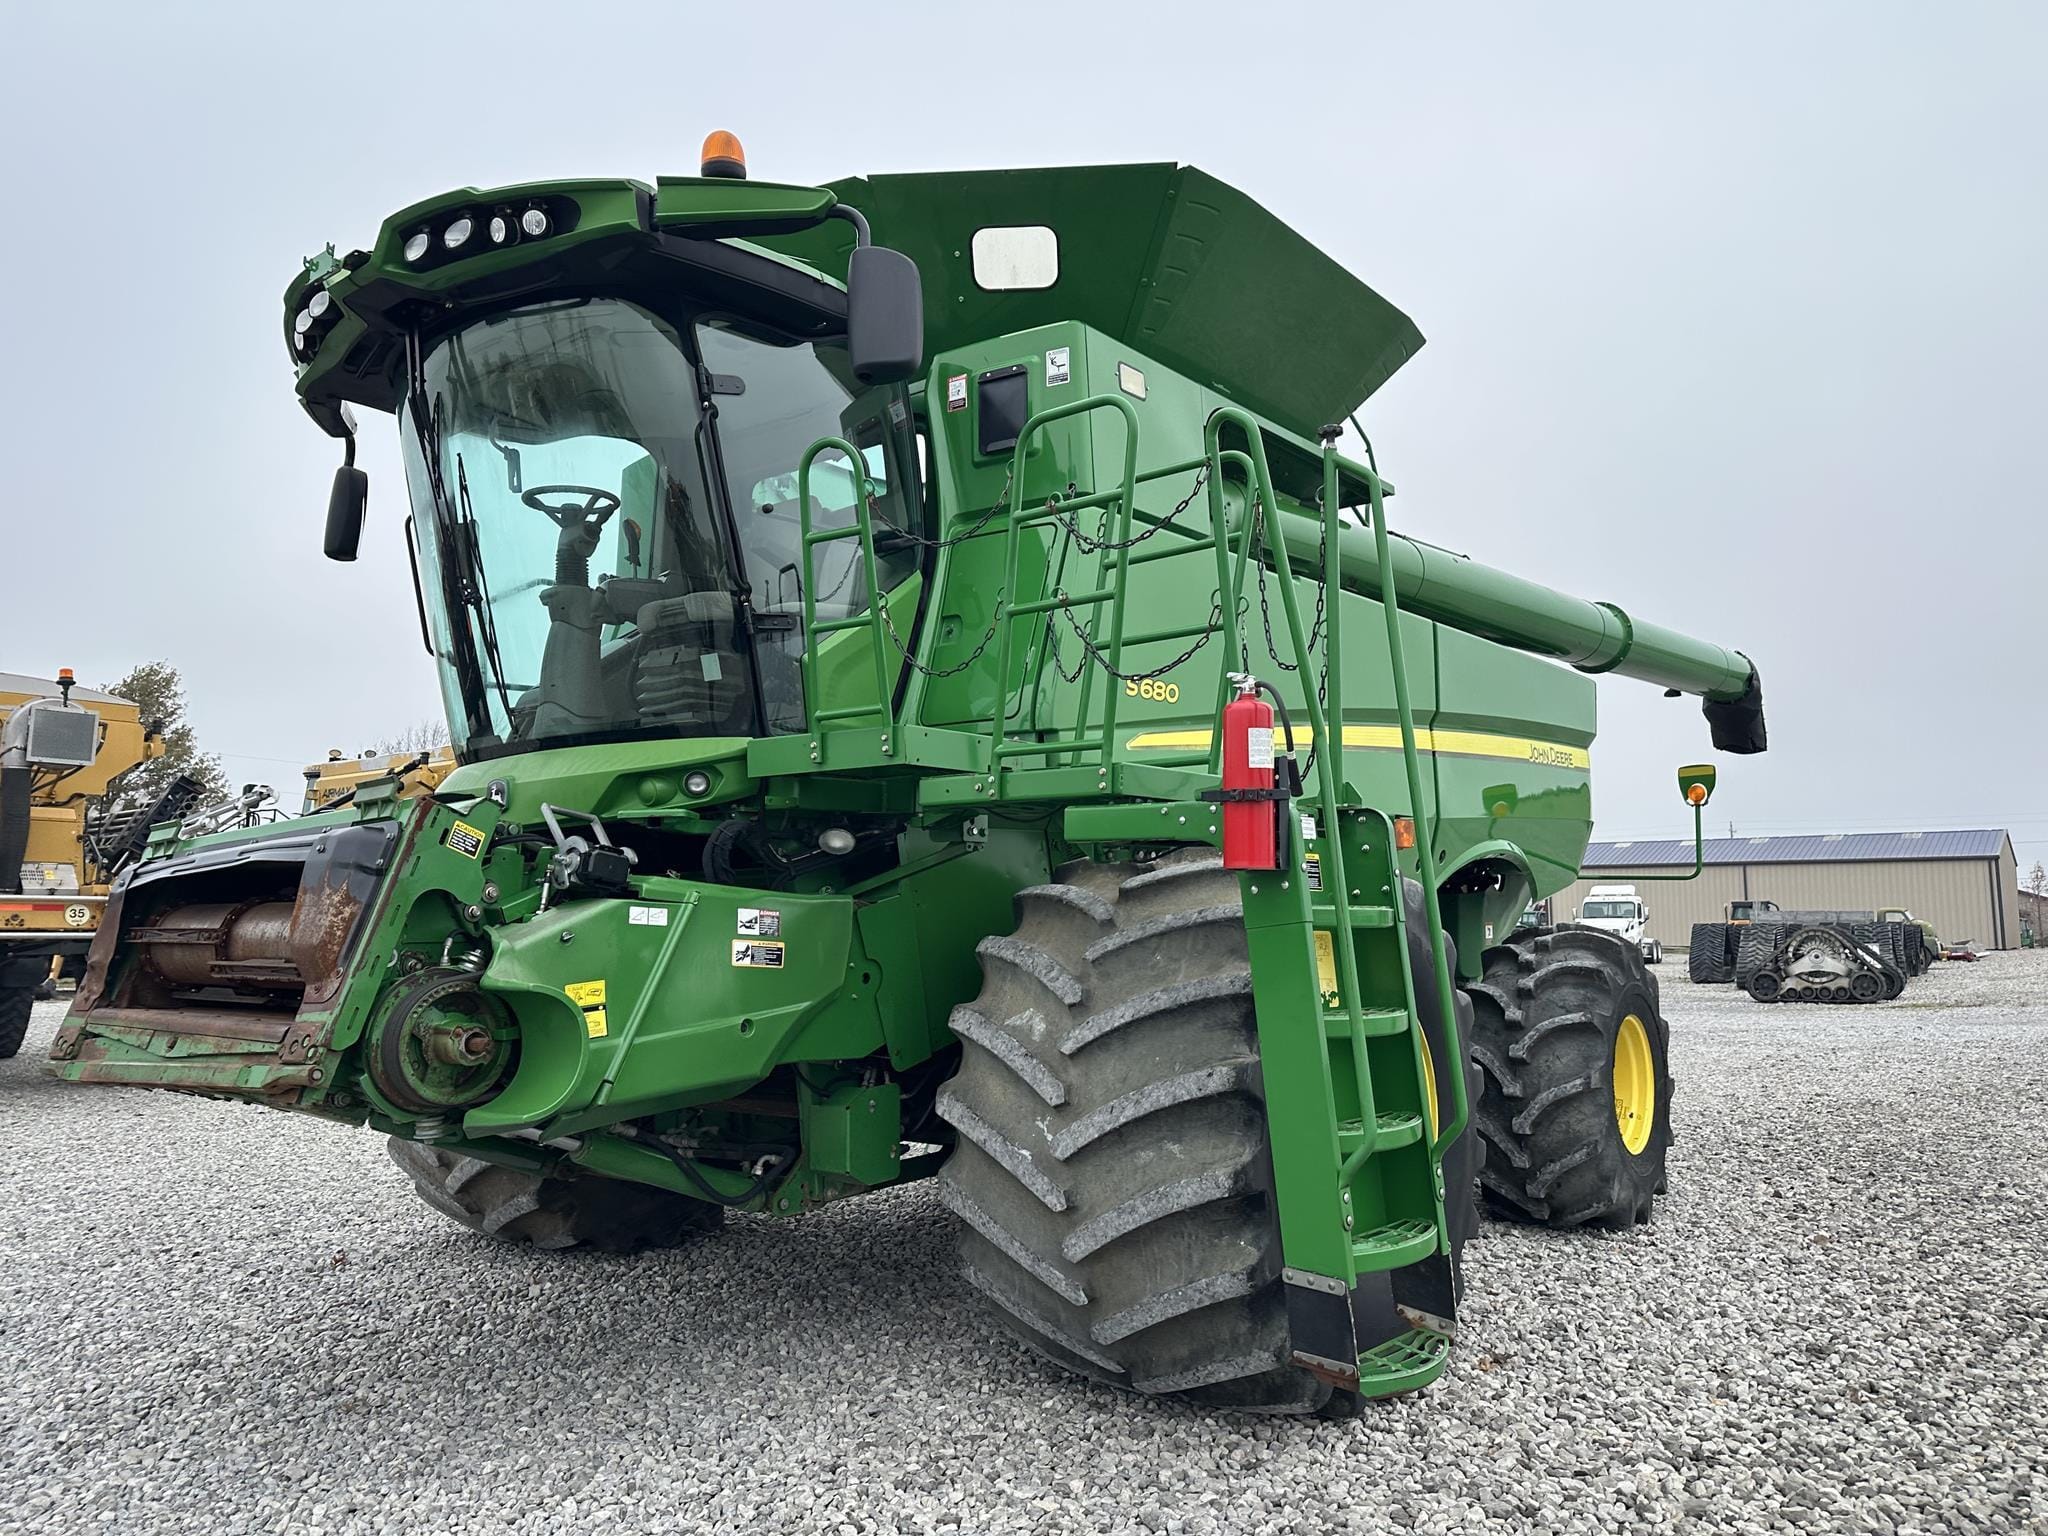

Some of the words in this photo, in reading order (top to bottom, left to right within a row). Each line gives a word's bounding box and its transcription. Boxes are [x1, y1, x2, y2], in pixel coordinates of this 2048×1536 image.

[1125, 677, 1180, 704] S680
[1529, 744, 1549, 761] JOHN
[1549, 747, 1574, 766] DEERE
[461, 824, 484, 839] CAUTION
[69, 908, 86, 918] 35
